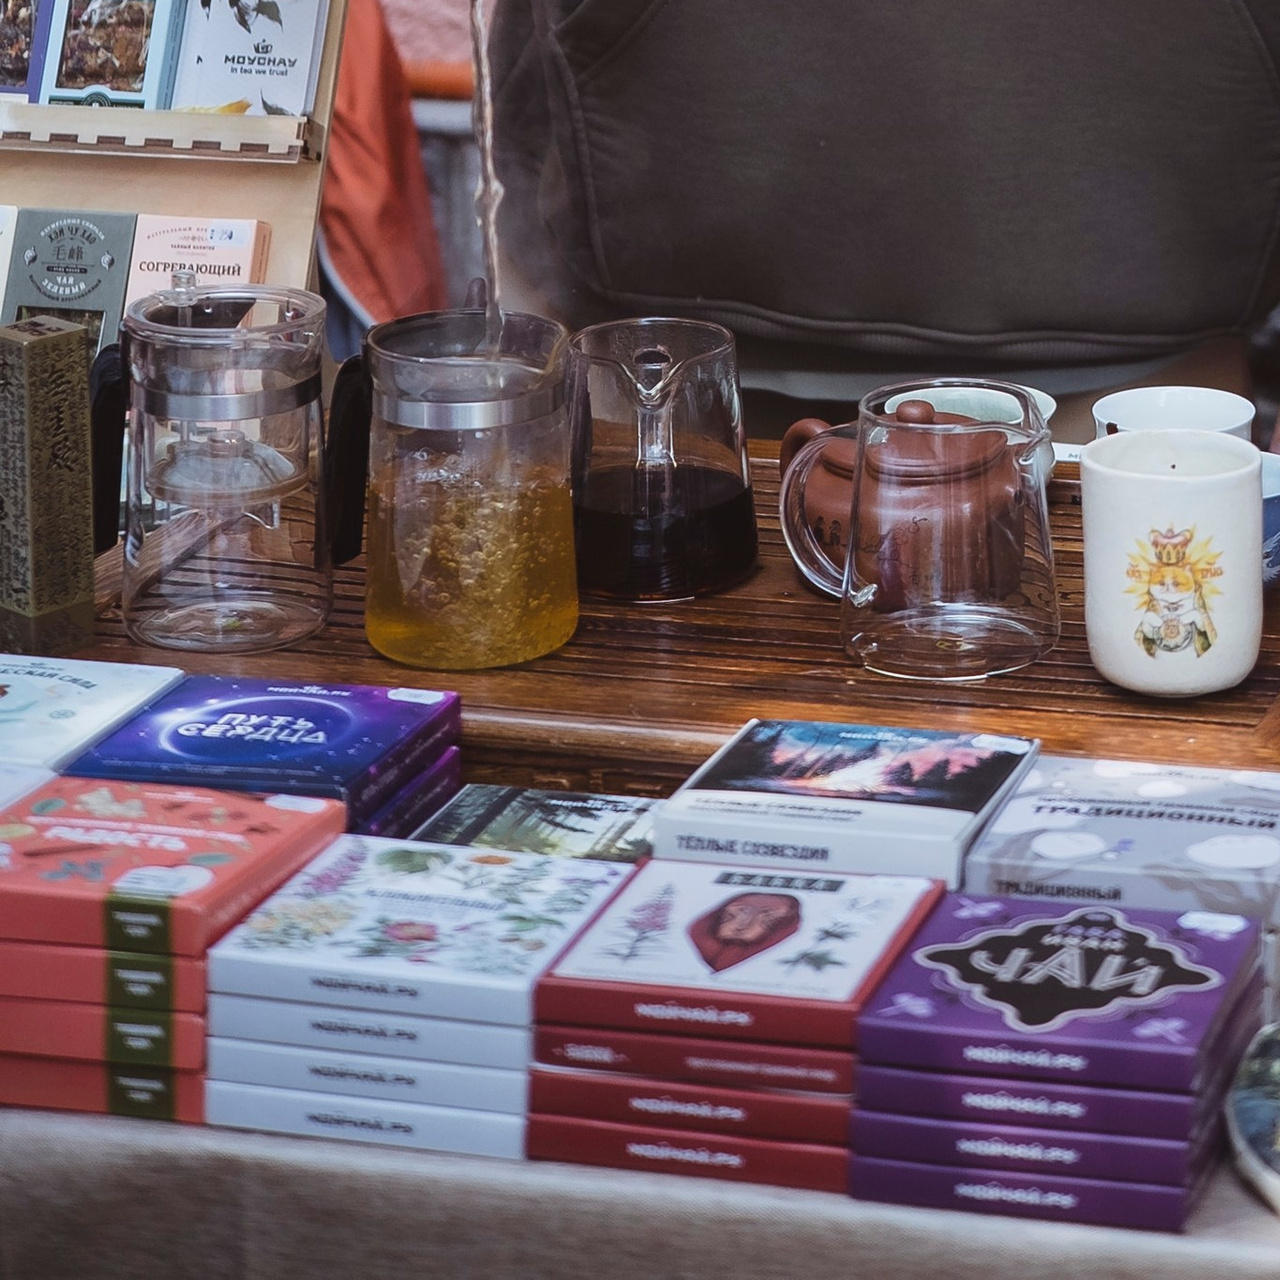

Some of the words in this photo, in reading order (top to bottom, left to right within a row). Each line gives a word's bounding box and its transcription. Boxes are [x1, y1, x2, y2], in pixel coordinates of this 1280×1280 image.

[56, 275, 75, 285] ЧАЙ
[177, 722, 328, 744] СЕРДЦА
[217, 713, 317, 731] ПУТЬ
[1032, 804, 1277, 829] ТРАДИЦИОННЫЙ
[969, 944, 1166, 995] ЧАЙ
